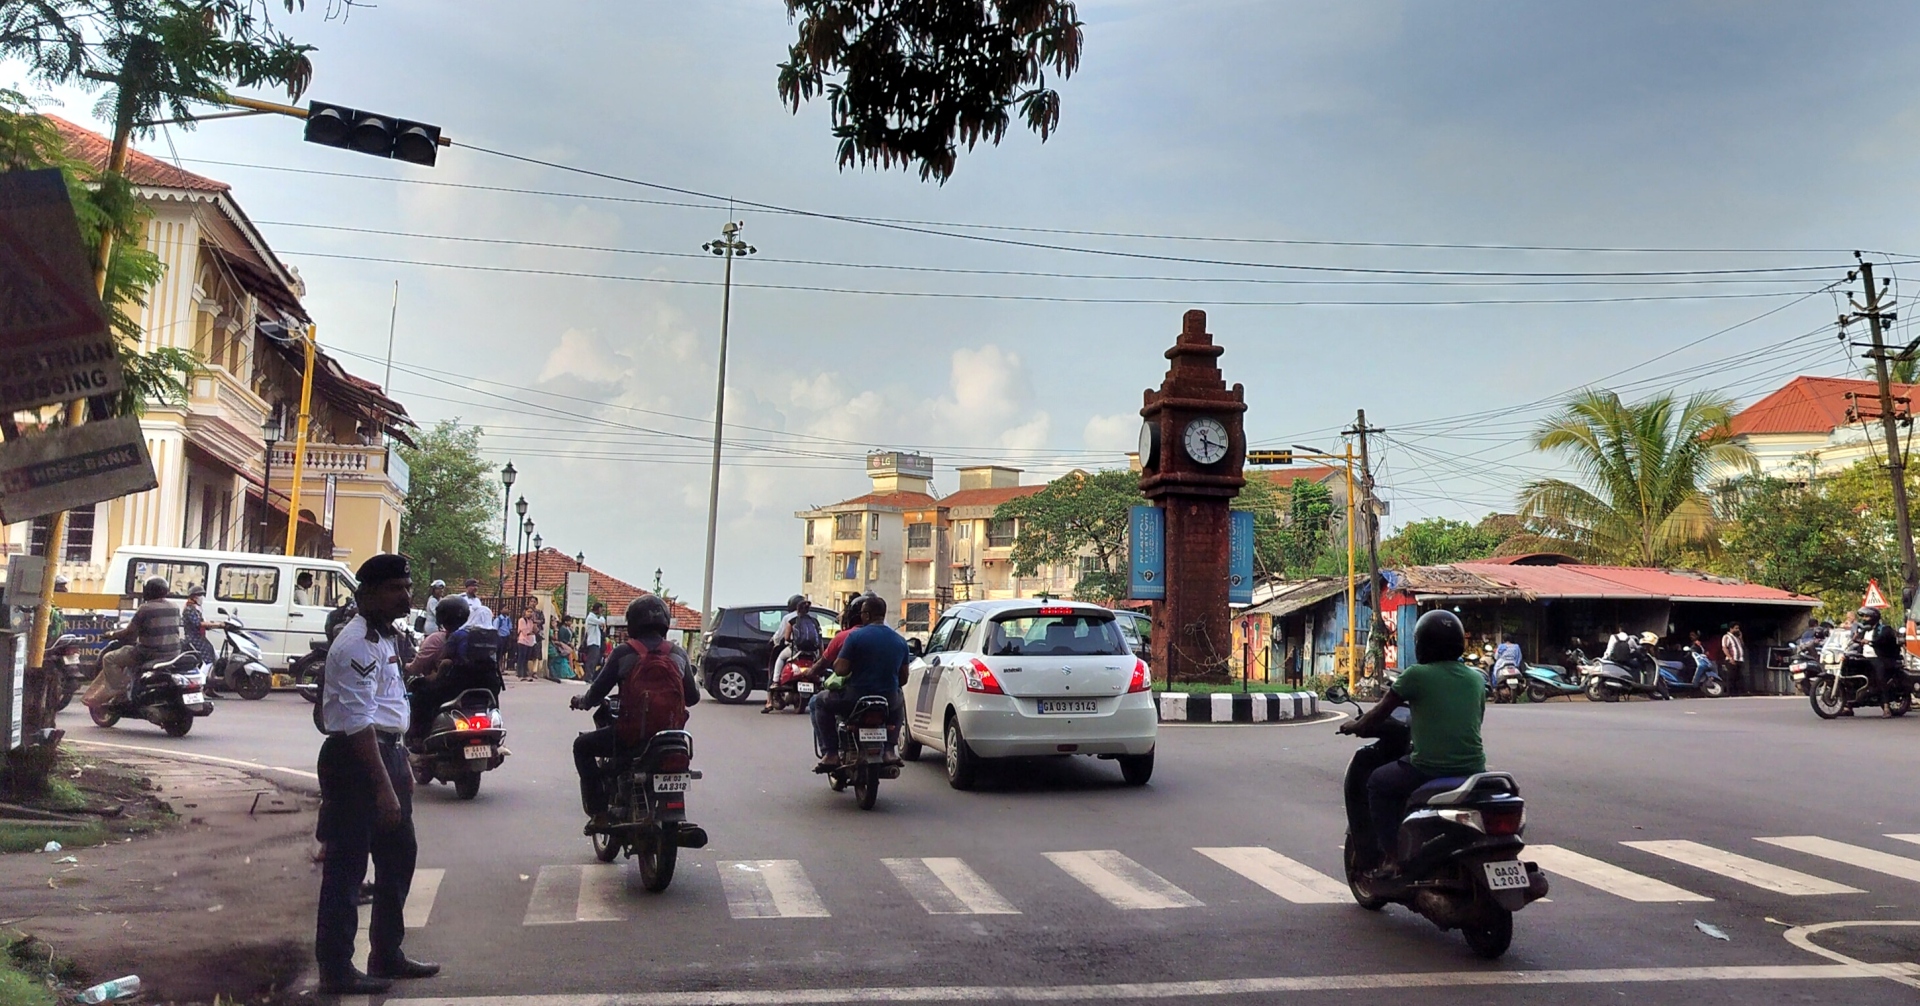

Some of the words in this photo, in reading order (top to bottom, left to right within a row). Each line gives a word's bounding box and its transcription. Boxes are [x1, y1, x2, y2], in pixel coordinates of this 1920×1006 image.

[84, 449, 133, 469] BANK
[881, 457, 891, 466] LG
[915, 459, 925, 468] LG
[1043, 701, 1055, 711] GA
[1056, 701, 1067, 711] 03
[1069, 701, 1074, 711] Y
[1075, 701, 1097, 711] 3143
